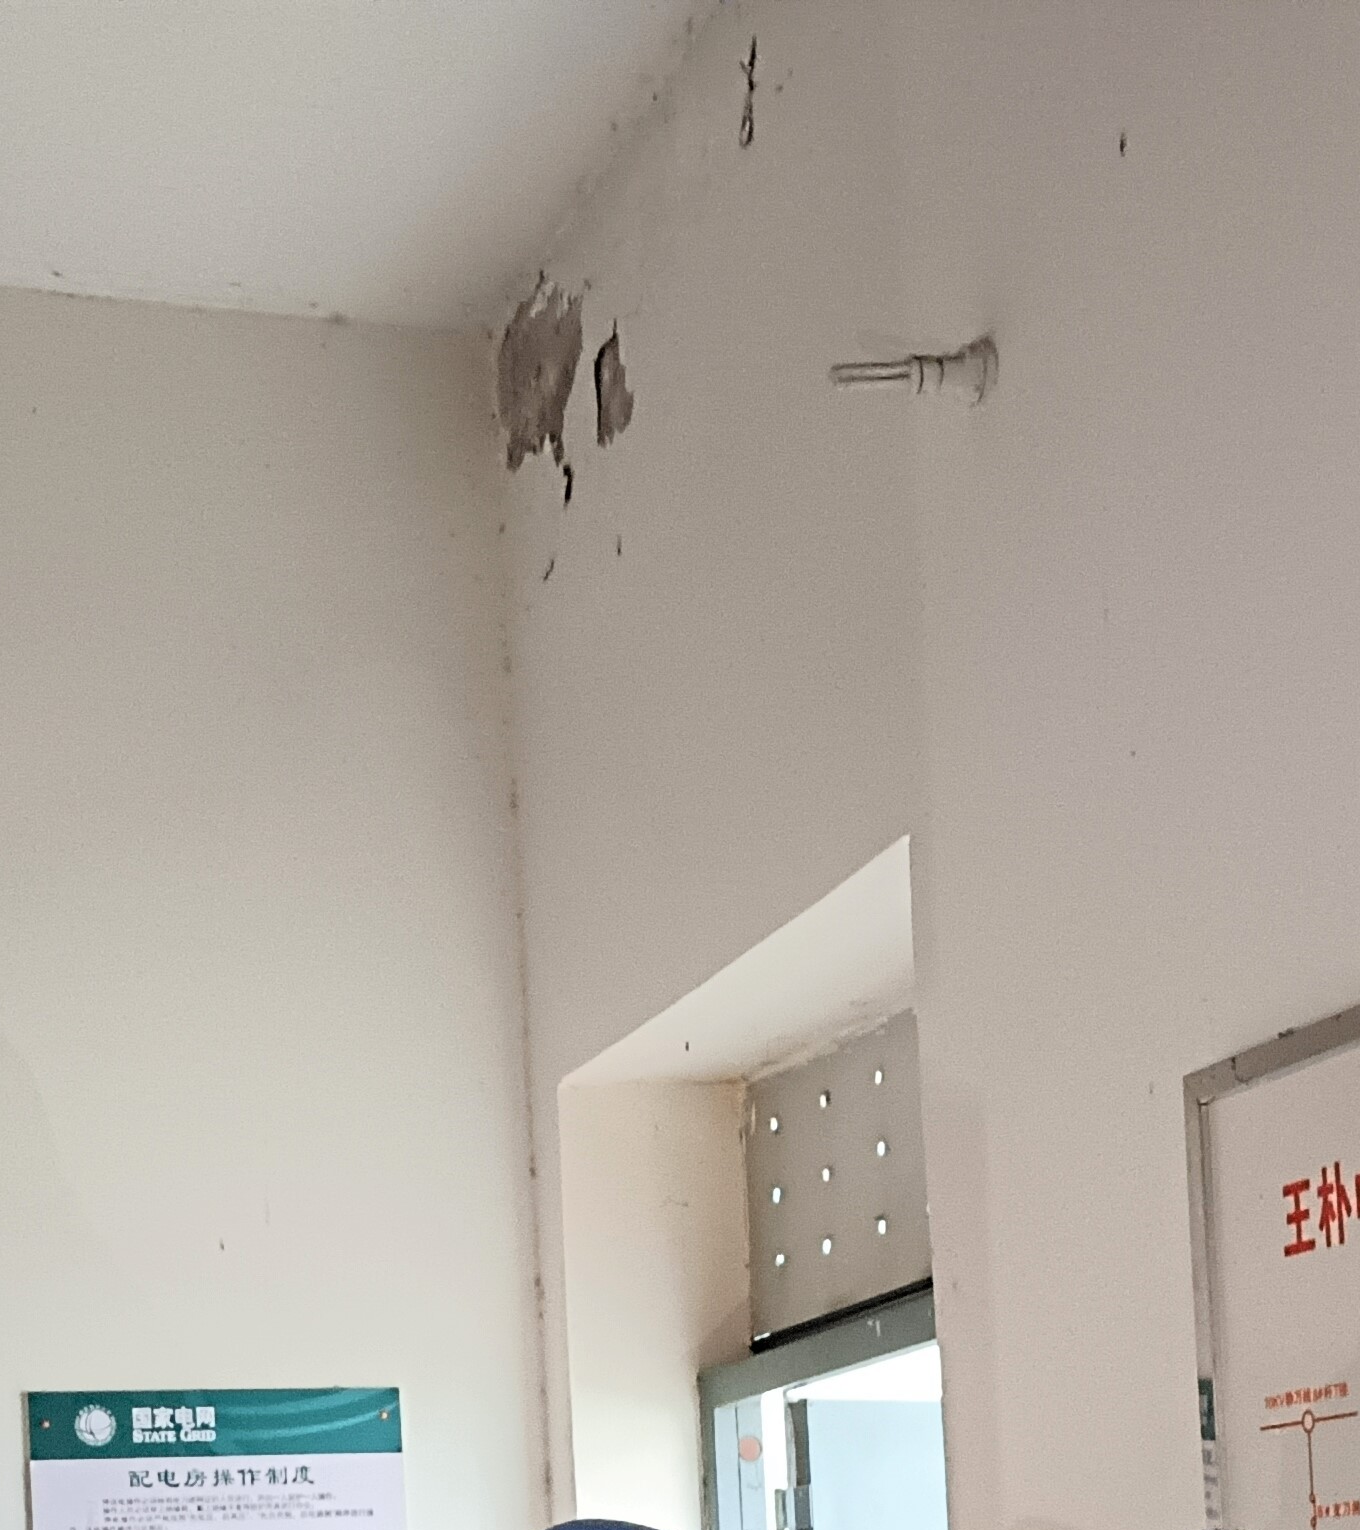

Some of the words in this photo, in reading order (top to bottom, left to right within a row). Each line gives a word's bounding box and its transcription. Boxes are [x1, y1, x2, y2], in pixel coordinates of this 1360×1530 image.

[132, 1406, 216, 1429] 国家电网
[132, 1428, 177, 1443] STATE
[180, 1427, 217, 1442] GRID
[128, 1465, 315, 1489] 配电房操作制度
